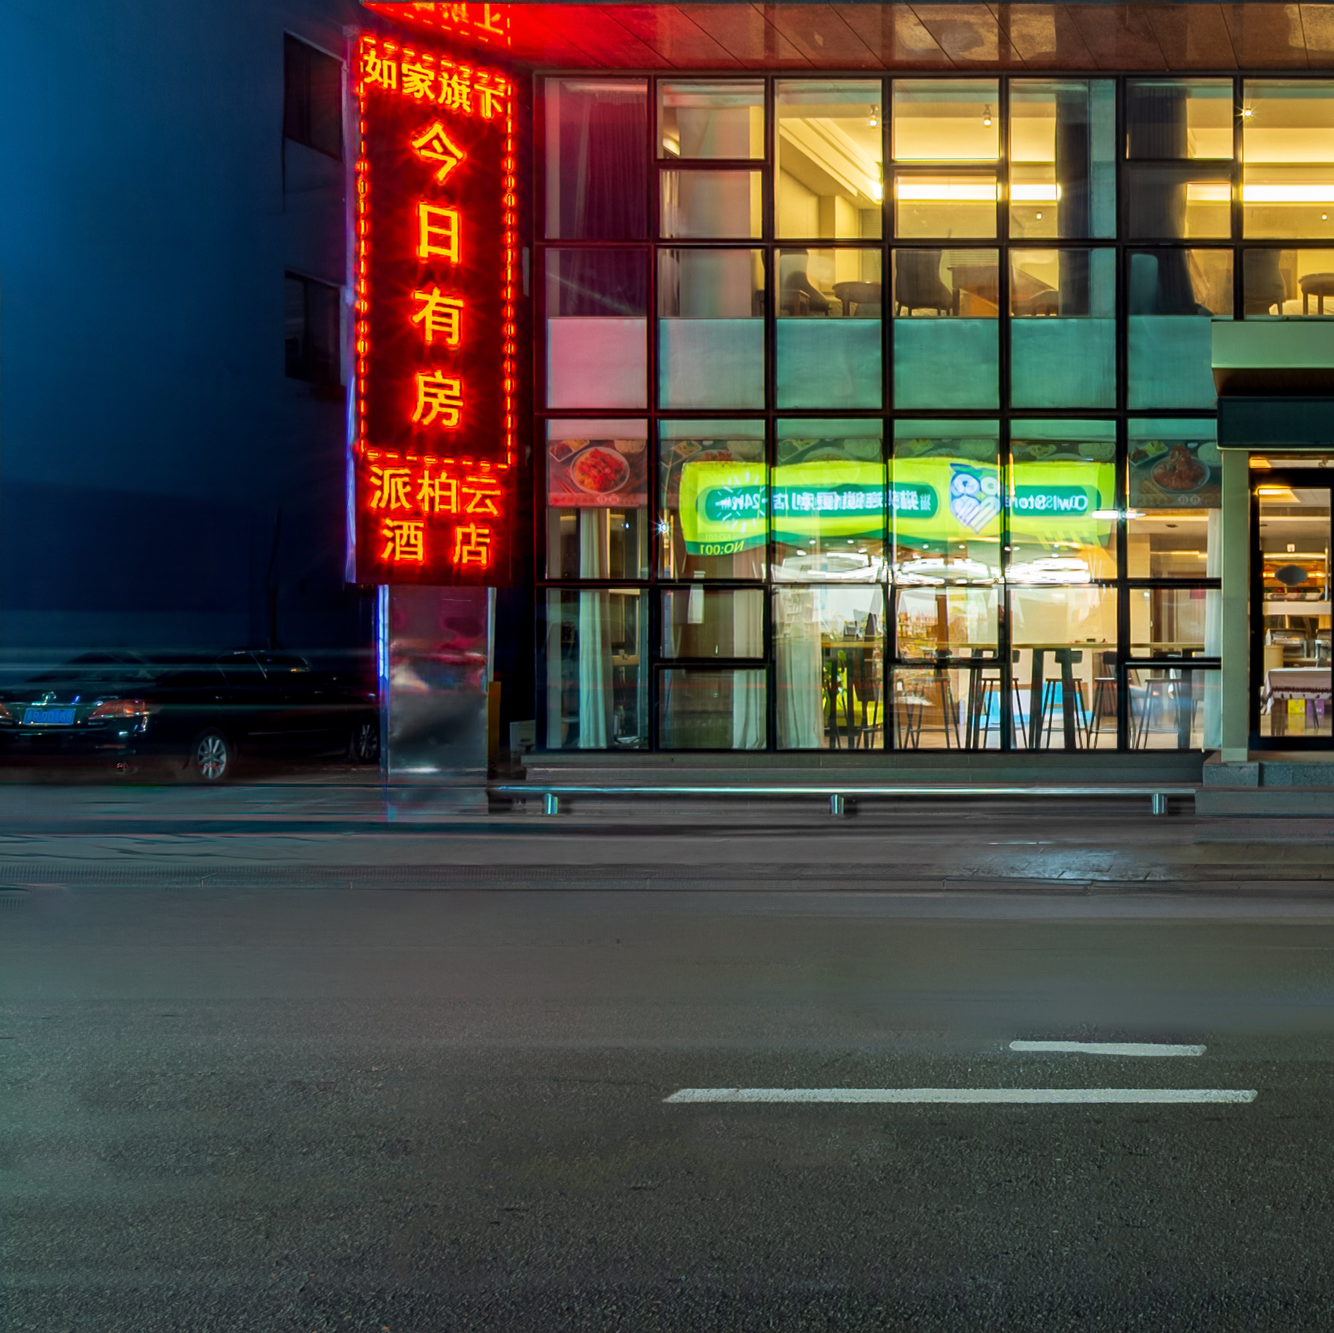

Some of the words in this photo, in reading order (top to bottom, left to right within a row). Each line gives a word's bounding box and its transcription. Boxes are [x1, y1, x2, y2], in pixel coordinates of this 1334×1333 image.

[362, 49, 503, 121] 如家旗下
[411, 120, 467, 429] 今日有房
[369, 465, 502, 516] 派柏云
[380, 517, 492, 566] 酒店
